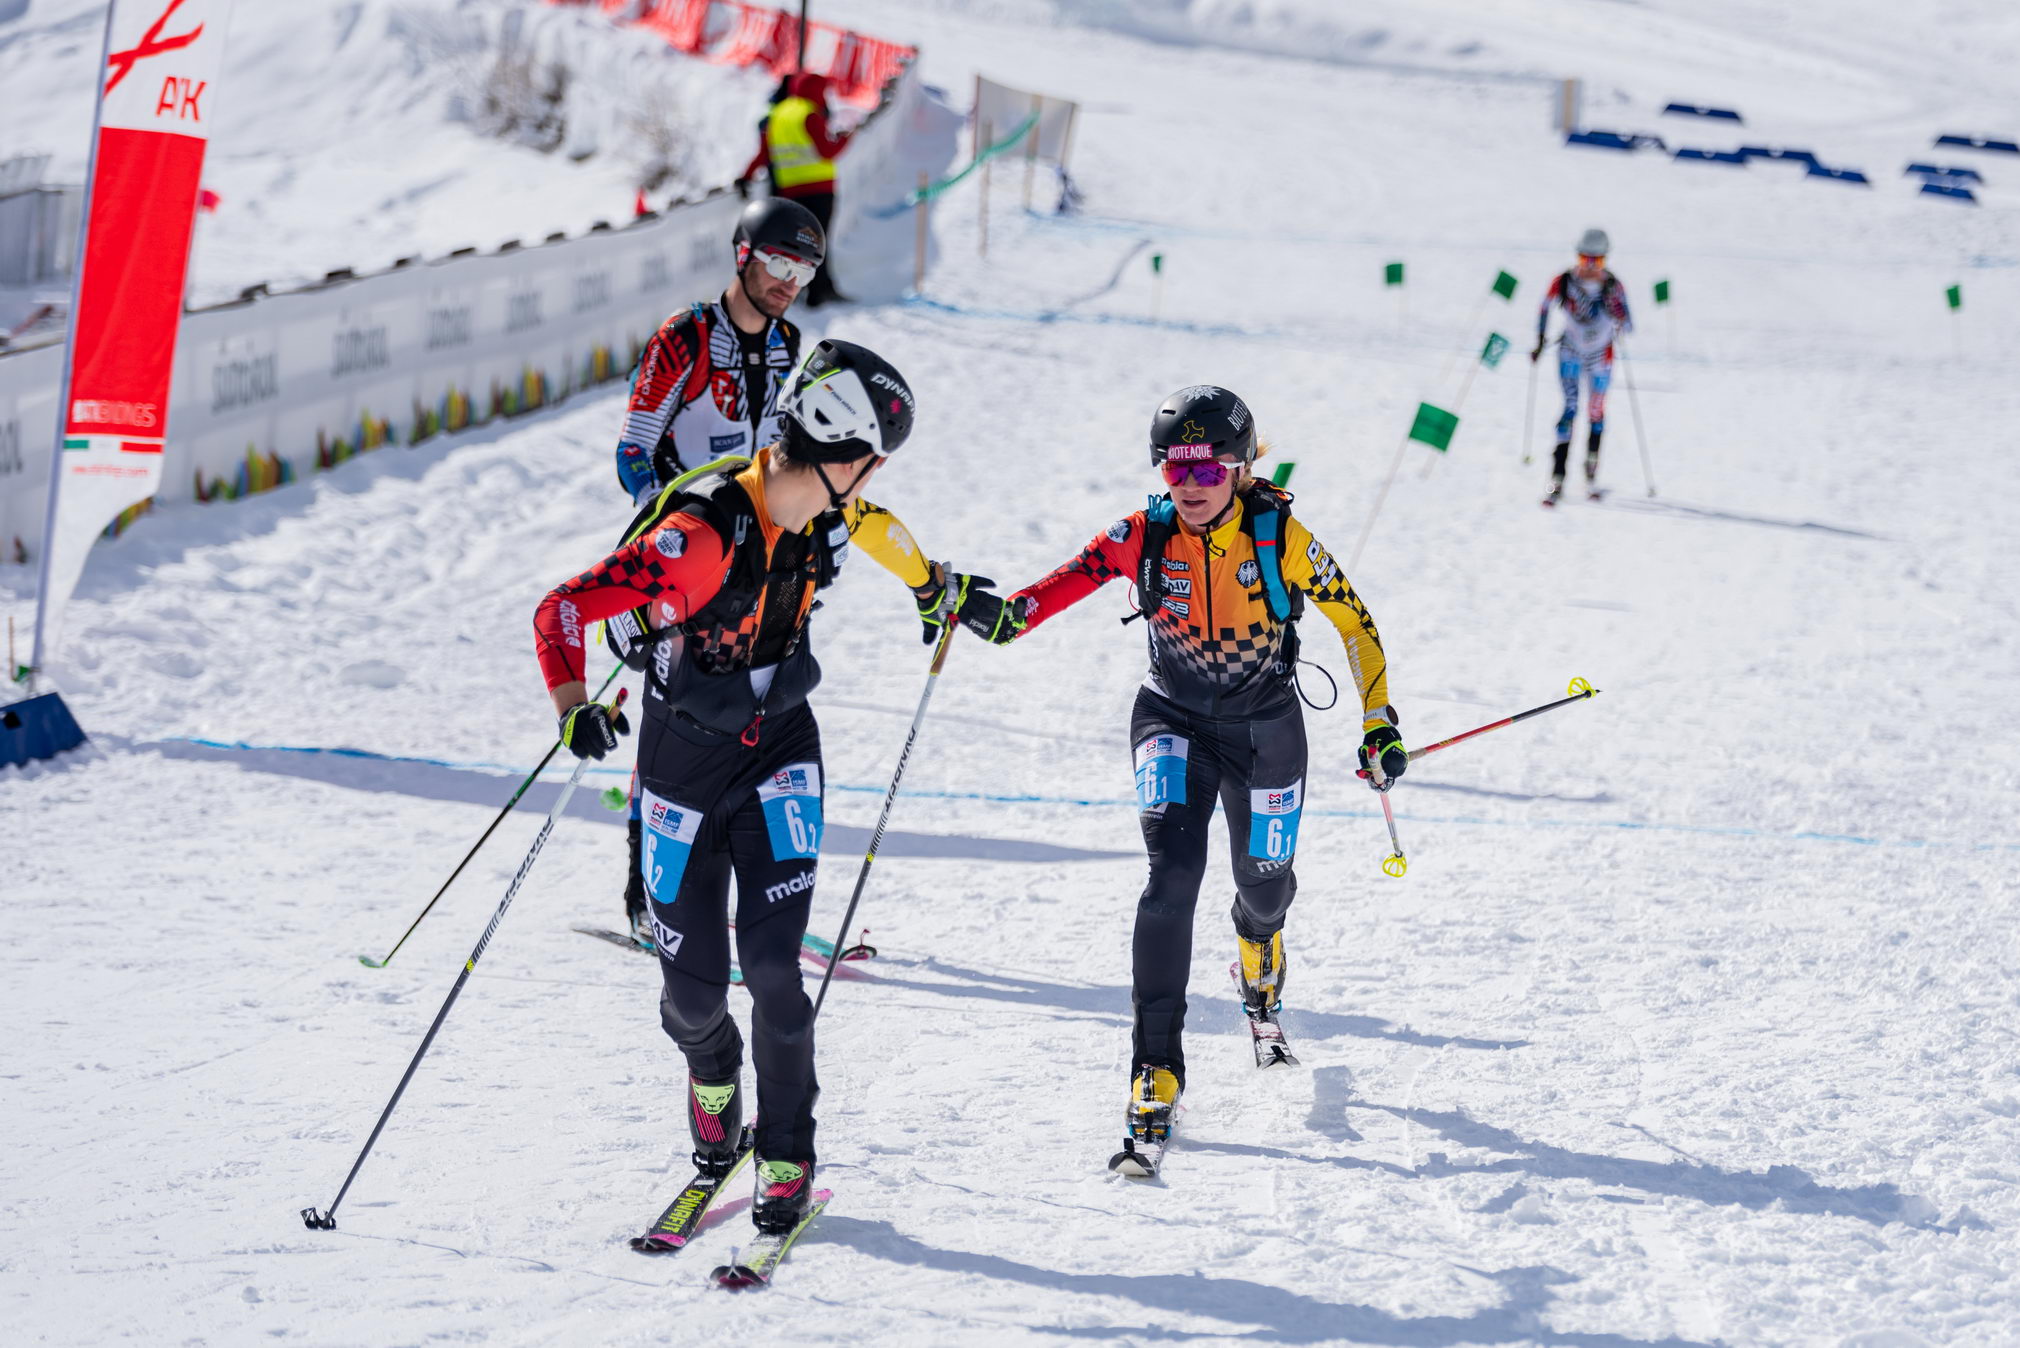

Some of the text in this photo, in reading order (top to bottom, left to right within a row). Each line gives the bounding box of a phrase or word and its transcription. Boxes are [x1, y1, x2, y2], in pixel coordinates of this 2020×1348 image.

[1168, 446, 1212, 459] BIOTEAQUE
[1145, 762, 1168, 804] 6.1
[1266, 818, 1292, 858] 6.1
[660, 1189, 706, 1233] DYNAFIT
